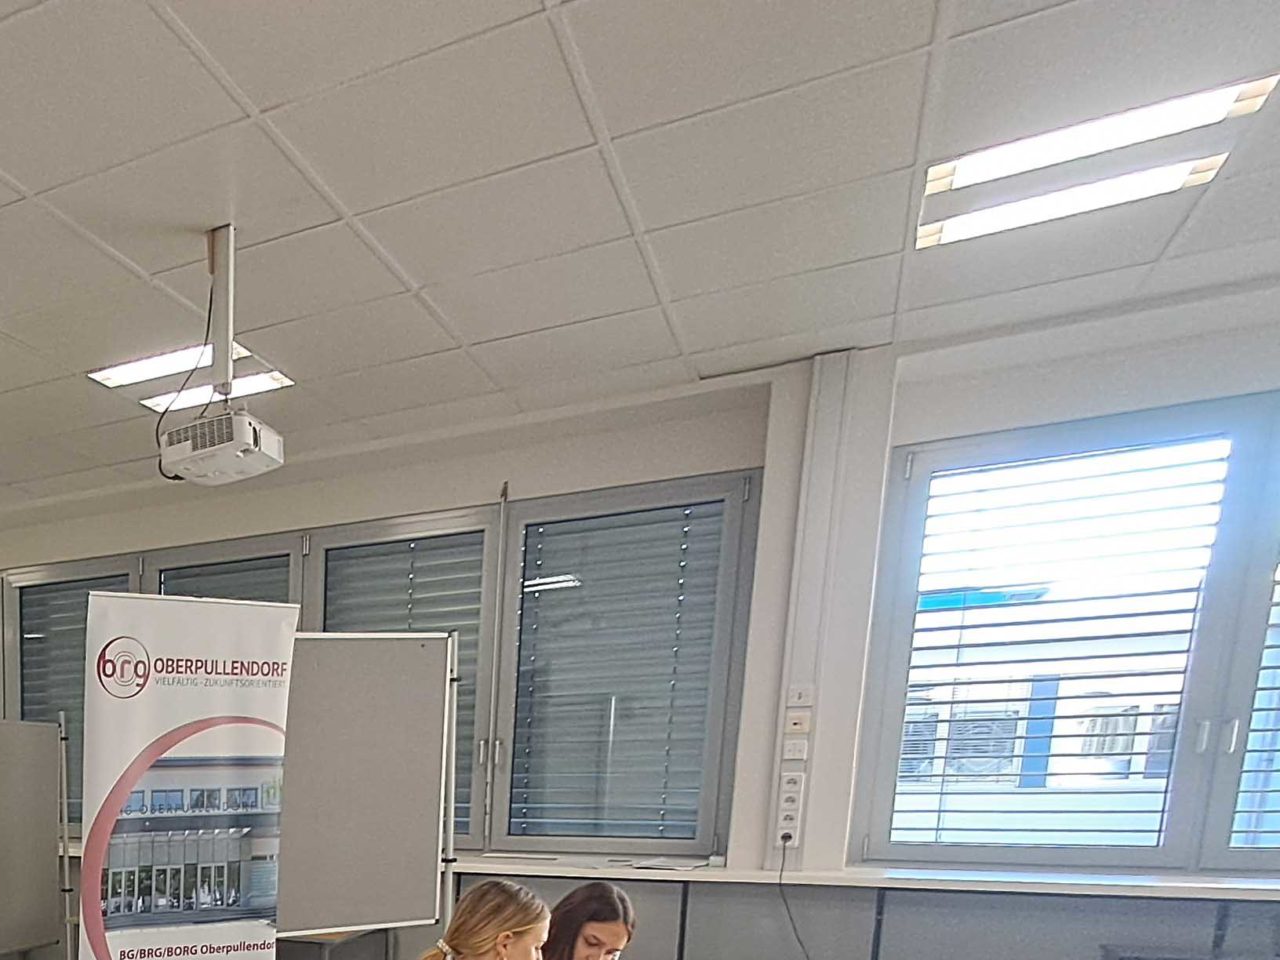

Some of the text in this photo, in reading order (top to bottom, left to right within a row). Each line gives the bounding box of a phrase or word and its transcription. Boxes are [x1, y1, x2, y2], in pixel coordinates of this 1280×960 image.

[101, 648, 287, 688] brg OBERPULLENDORF
[119, 940, 275, 960] BG/BRG/BORG Oberpullendor
